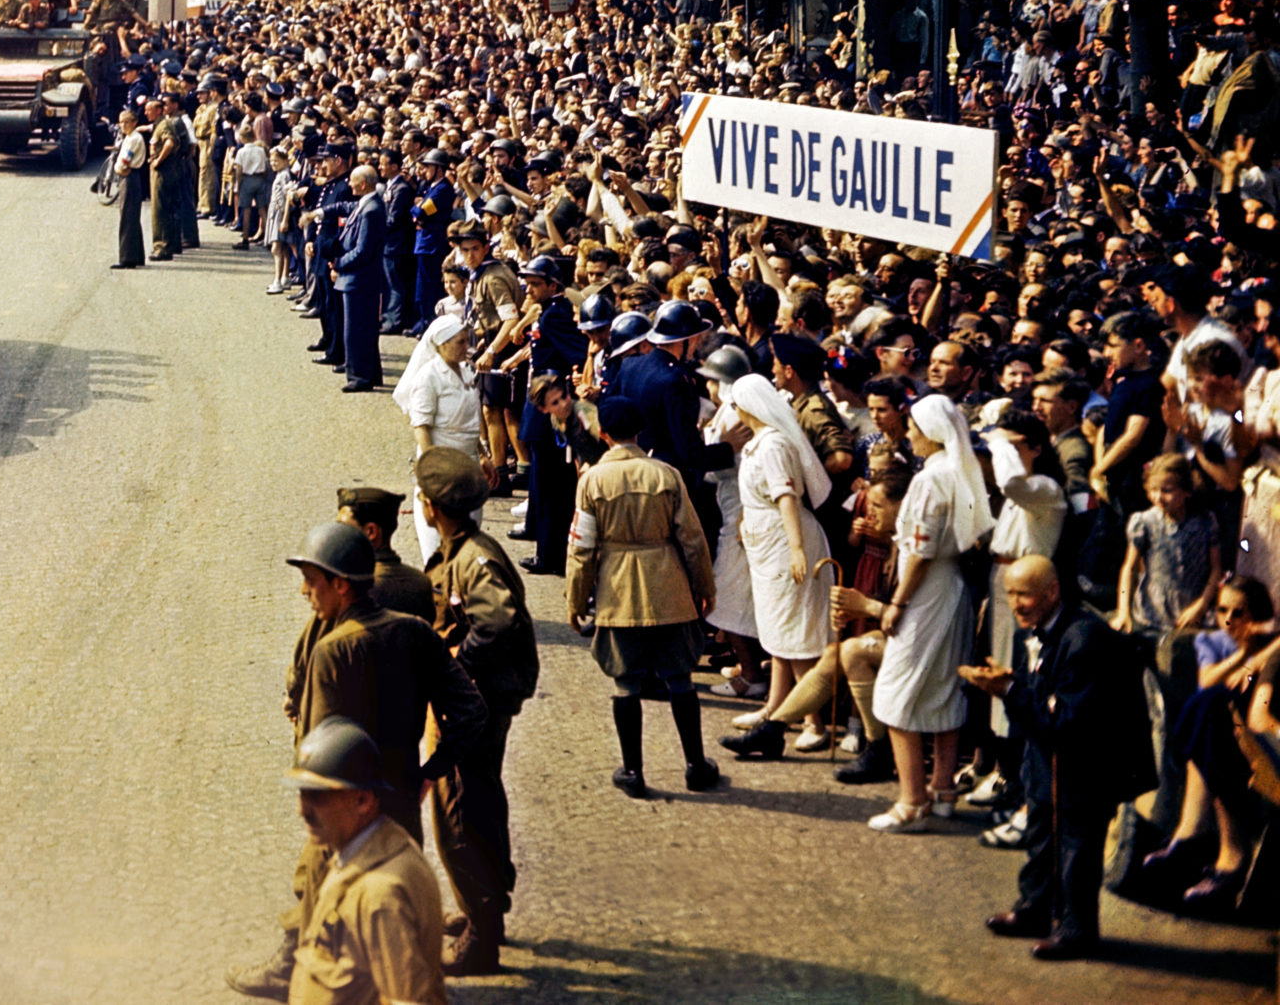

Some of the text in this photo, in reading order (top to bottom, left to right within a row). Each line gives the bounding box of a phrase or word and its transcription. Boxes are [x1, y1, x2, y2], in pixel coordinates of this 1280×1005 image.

[708, 117, 954, 227] VIVE DE GAULLE
